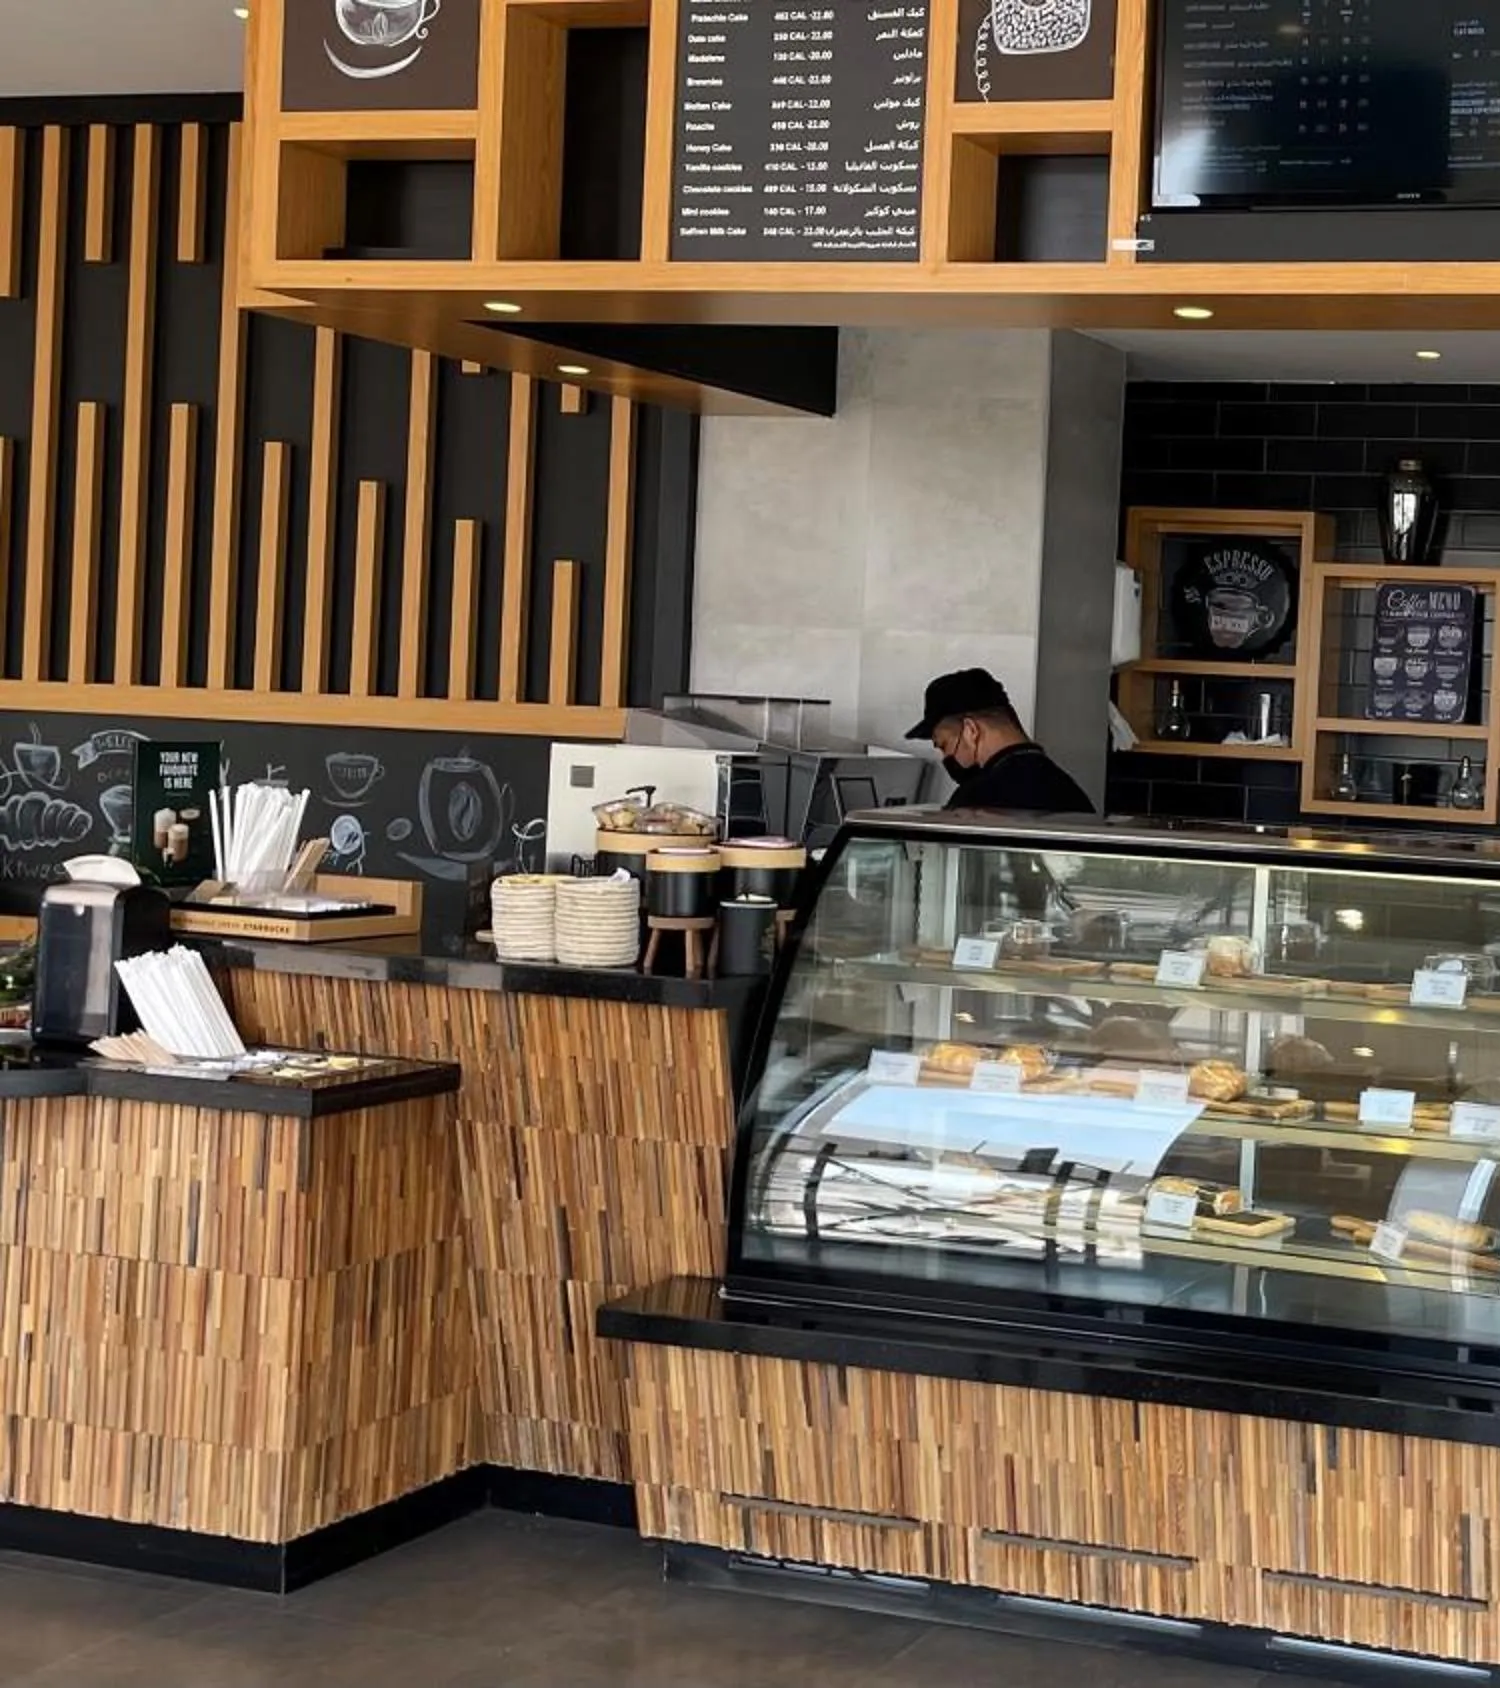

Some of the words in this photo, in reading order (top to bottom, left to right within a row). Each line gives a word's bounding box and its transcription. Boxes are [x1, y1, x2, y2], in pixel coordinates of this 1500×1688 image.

[790, 52, 805, 60] CAL
[788, 76, 805, 84] CAL
[1204, 550, 1275, 581] ESPRESSO
[1429, 591, 1461, 610] MENU
[160, 751, 181, 763] YOUR
[181, 751, 199, 764] NEW
[163, 777, 173, 789] IS
[173, 777, 193, 790] HERE
